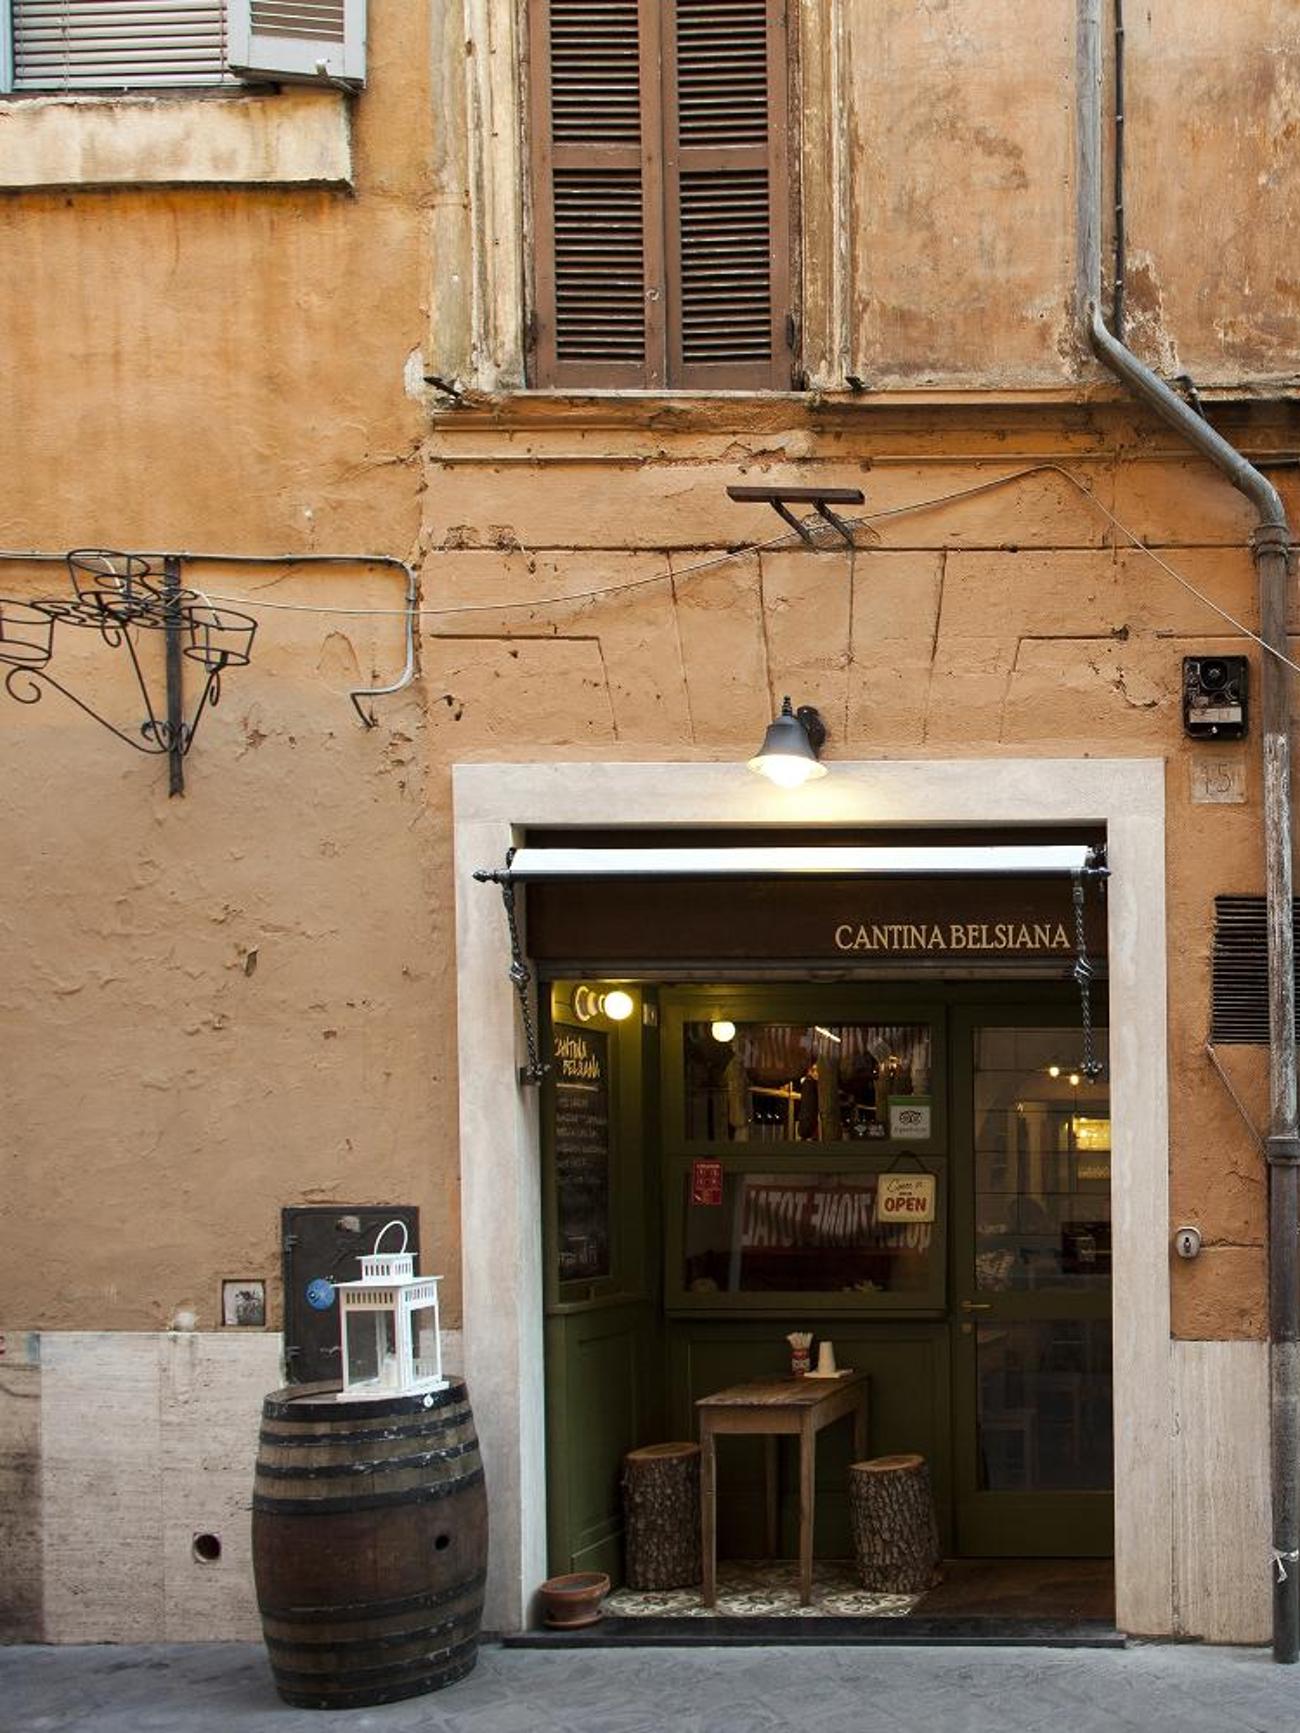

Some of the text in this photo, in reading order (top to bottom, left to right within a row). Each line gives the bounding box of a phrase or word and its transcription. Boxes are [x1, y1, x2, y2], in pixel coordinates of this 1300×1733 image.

[1203, 763, 1232, 793] 15
[835, 924, 1071, 950] CANTINA BELSIANA
[884, 1197, 927, 1213] OPEN
